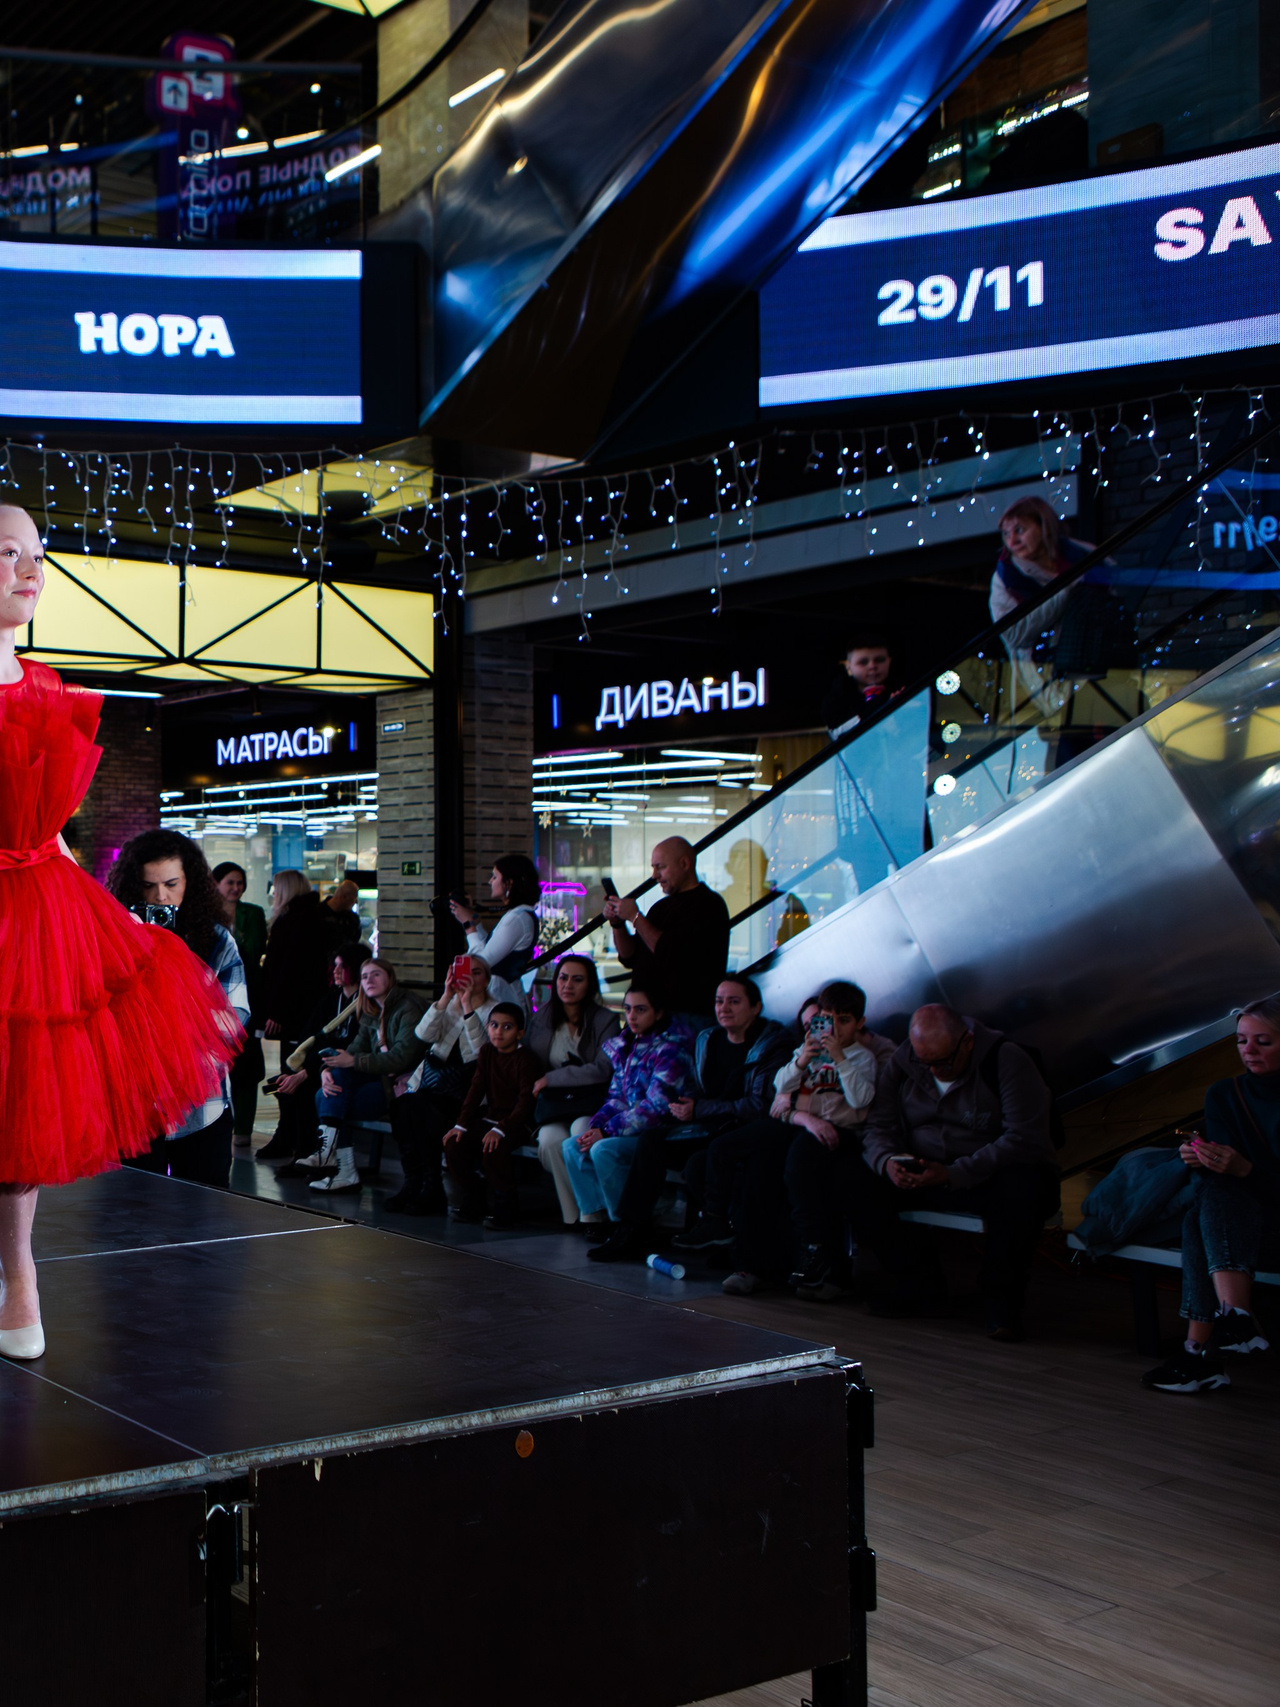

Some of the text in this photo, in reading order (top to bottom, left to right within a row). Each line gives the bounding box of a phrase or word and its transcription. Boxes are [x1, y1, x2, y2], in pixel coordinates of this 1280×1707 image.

[1154, 188, 1280, 262] SA
[877, 261, 1045, 327] 29/11
[595, 667, 767, 732] ДИВАНЫ
[216, 726, 332, 766] МАТРАСЫ
